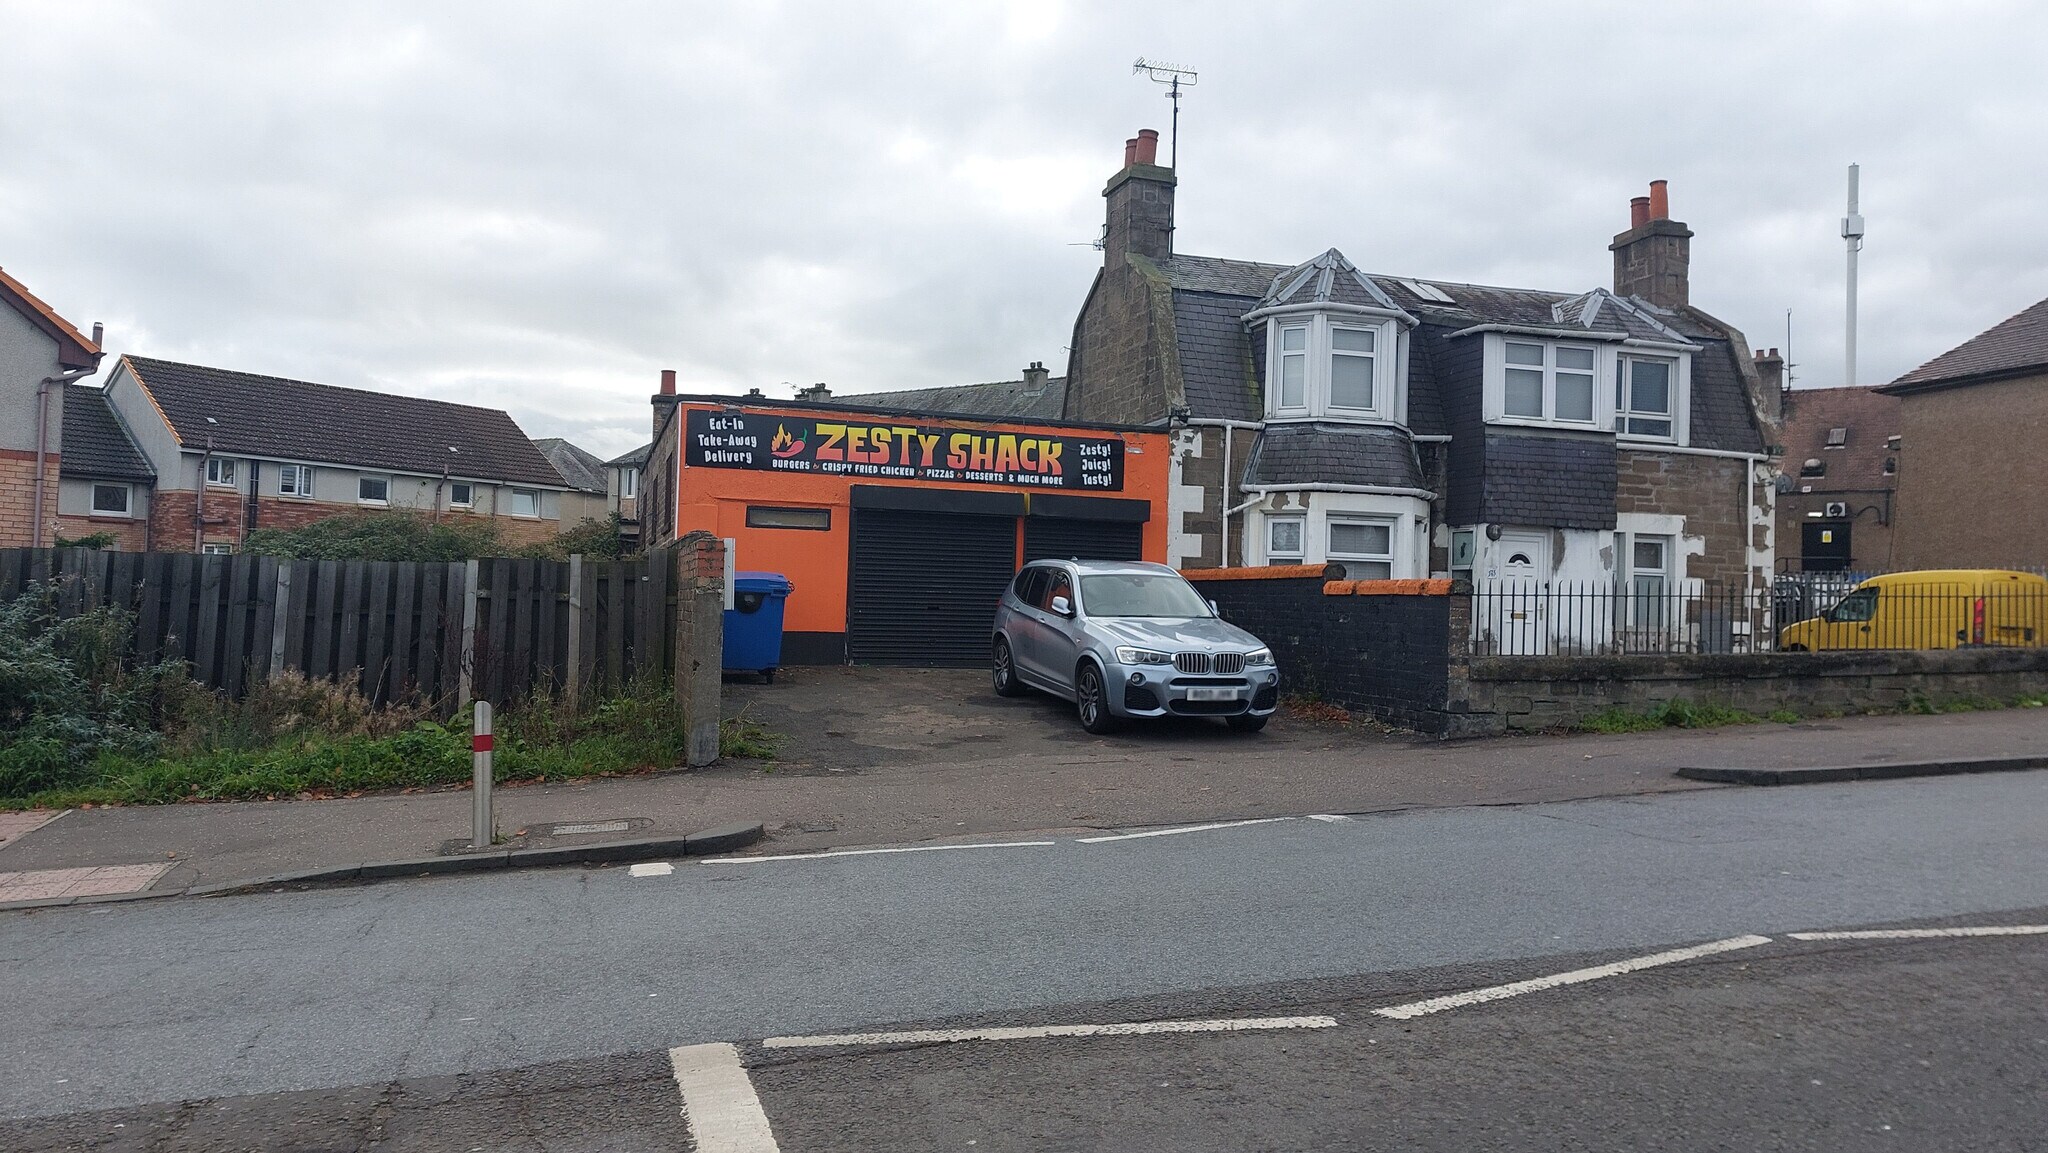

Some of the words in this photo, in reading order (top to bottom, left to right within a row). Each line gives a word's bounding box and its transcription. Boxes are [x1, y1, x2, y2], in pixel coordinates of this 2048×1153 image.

[709, 417, 744, 430] Eat-In
[697, 433, 757, 448] Take-Away
[704, 449, 752, 464] Delivery
[815, 423, 940, 467] ZESTY
[946, 433, 1063, 476] SHACK
[1079, 443, 1111, 457] Zesty!
[772, 459, 810, 470] BURGERS
[822, 462, 852, 473] CRISPY
[854, 464, 878, 474] FRIED
[880, 466, 915, 476] CHICKEN
[926, 468, 954, 479] PIZZAS
[965, 471, 1003, 482] DESSERTS
[1008, 473, 1015, 482] &
[1017, 474, 1040, 484] MUCH
[1041, 475, 1063, 485] MORE
[1081, 458, 1111, 472] Juicy!
[1081, 473, 1112, 487] Tasty!
